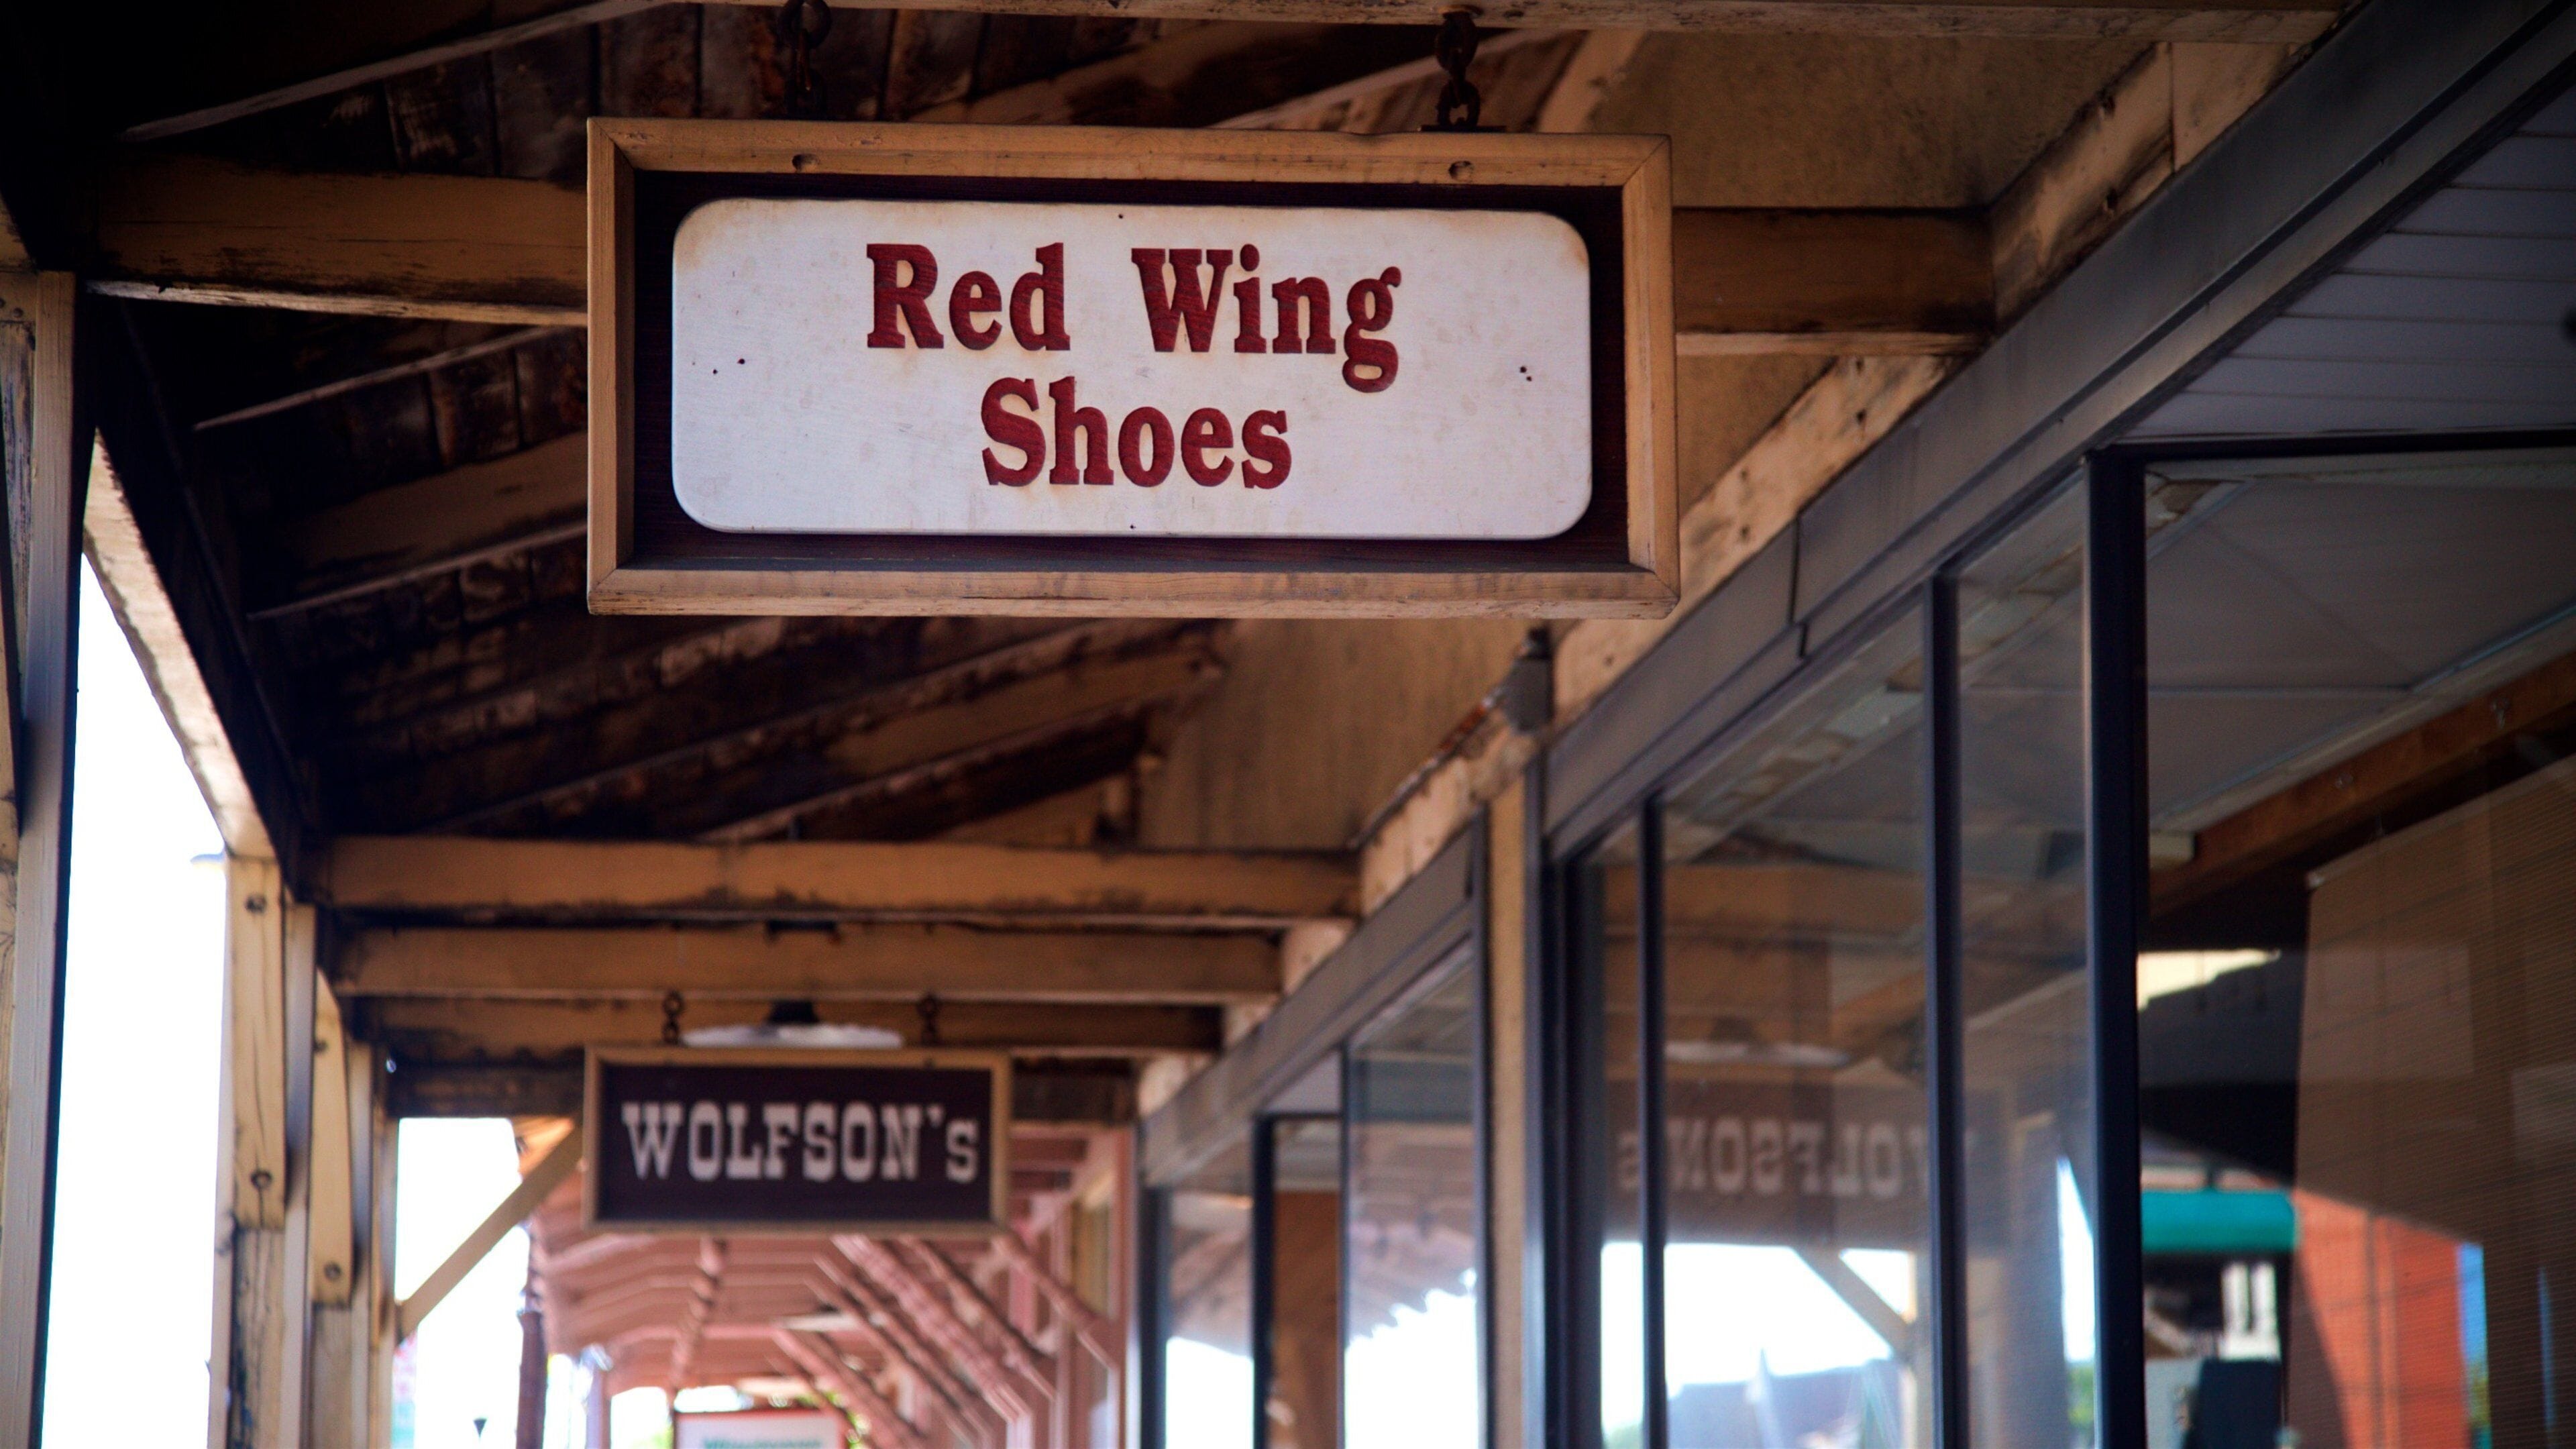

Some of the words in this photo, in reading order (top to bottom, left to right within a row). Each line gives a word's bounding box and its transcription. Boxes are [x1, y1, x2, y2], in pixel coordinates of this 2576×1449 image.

[867, 241, 1071, 350] Red
[1132, 245, 1402, 391] Wing
[981, 376, 1292, 490] Shoes
[622, 1102, 980, 1183] WOLFSON's
